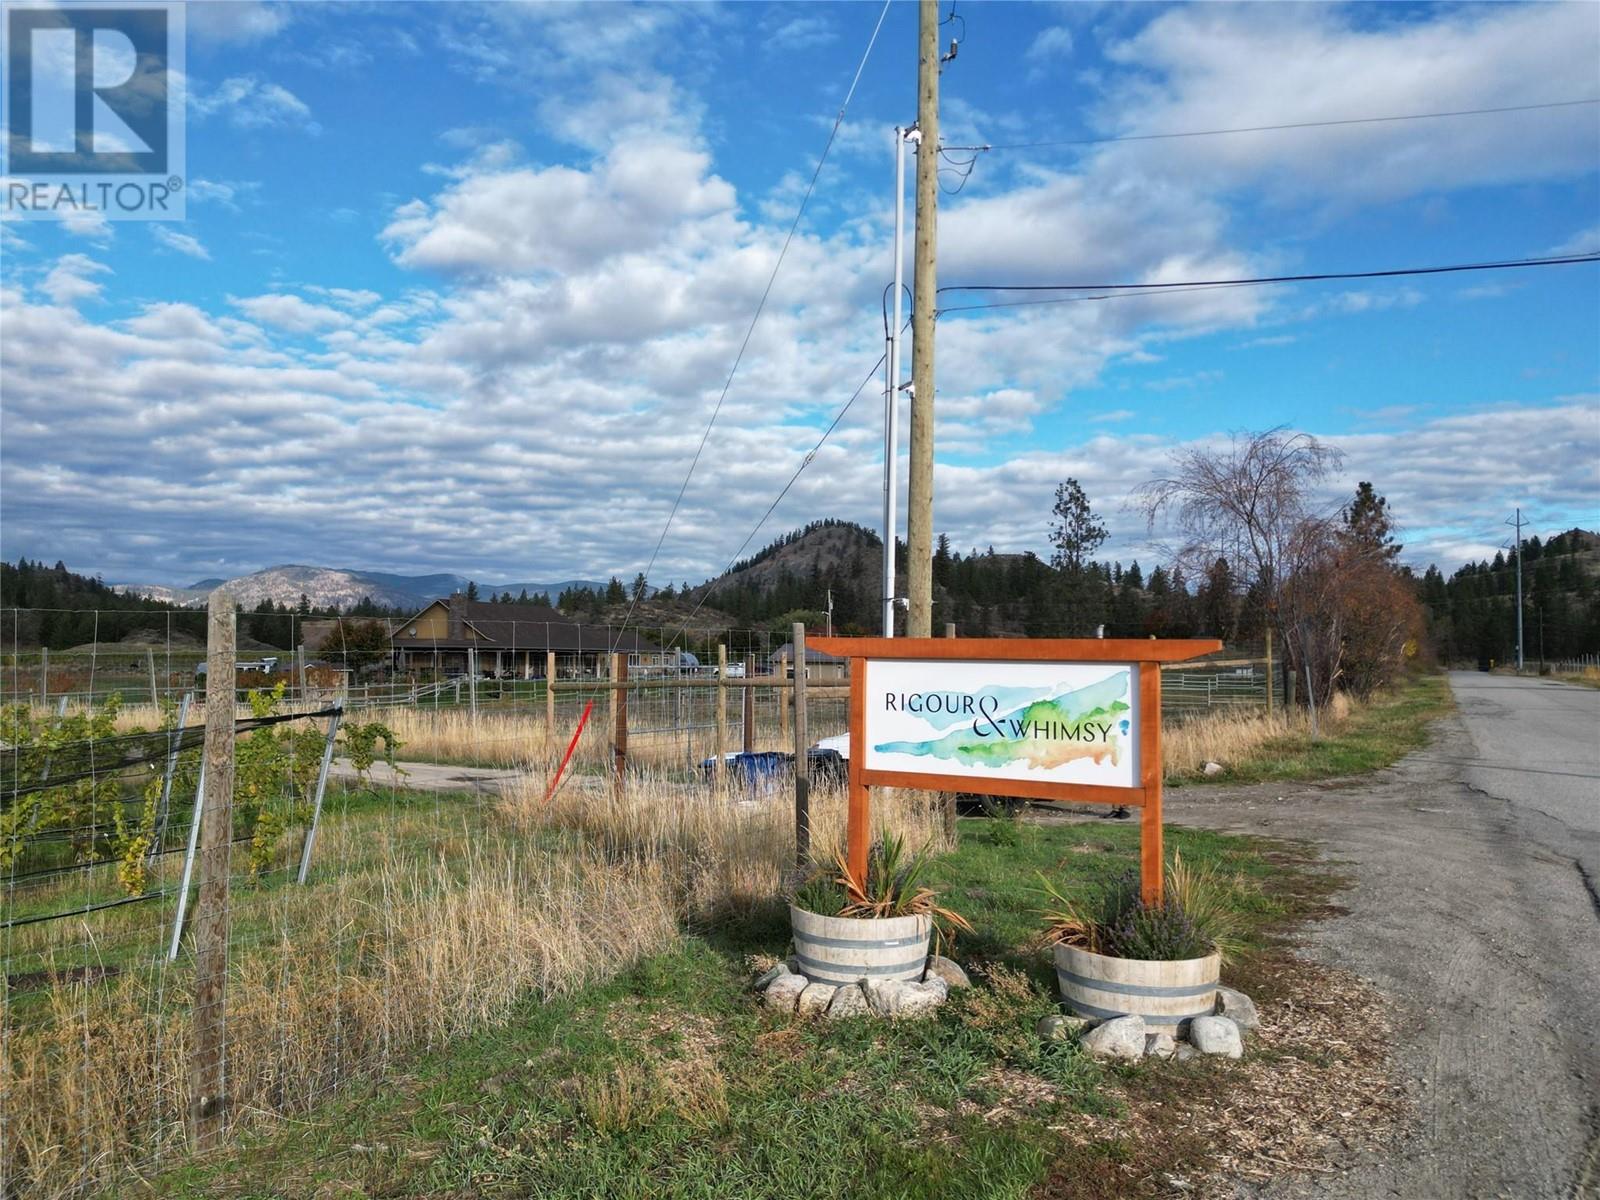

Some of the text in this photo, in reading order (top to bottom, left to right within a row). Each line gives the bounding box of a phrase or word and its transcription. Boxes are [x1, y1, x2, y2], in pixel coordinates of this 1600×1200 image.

[885, 692, 1113, 743] RIGOUR & WHIMSY
